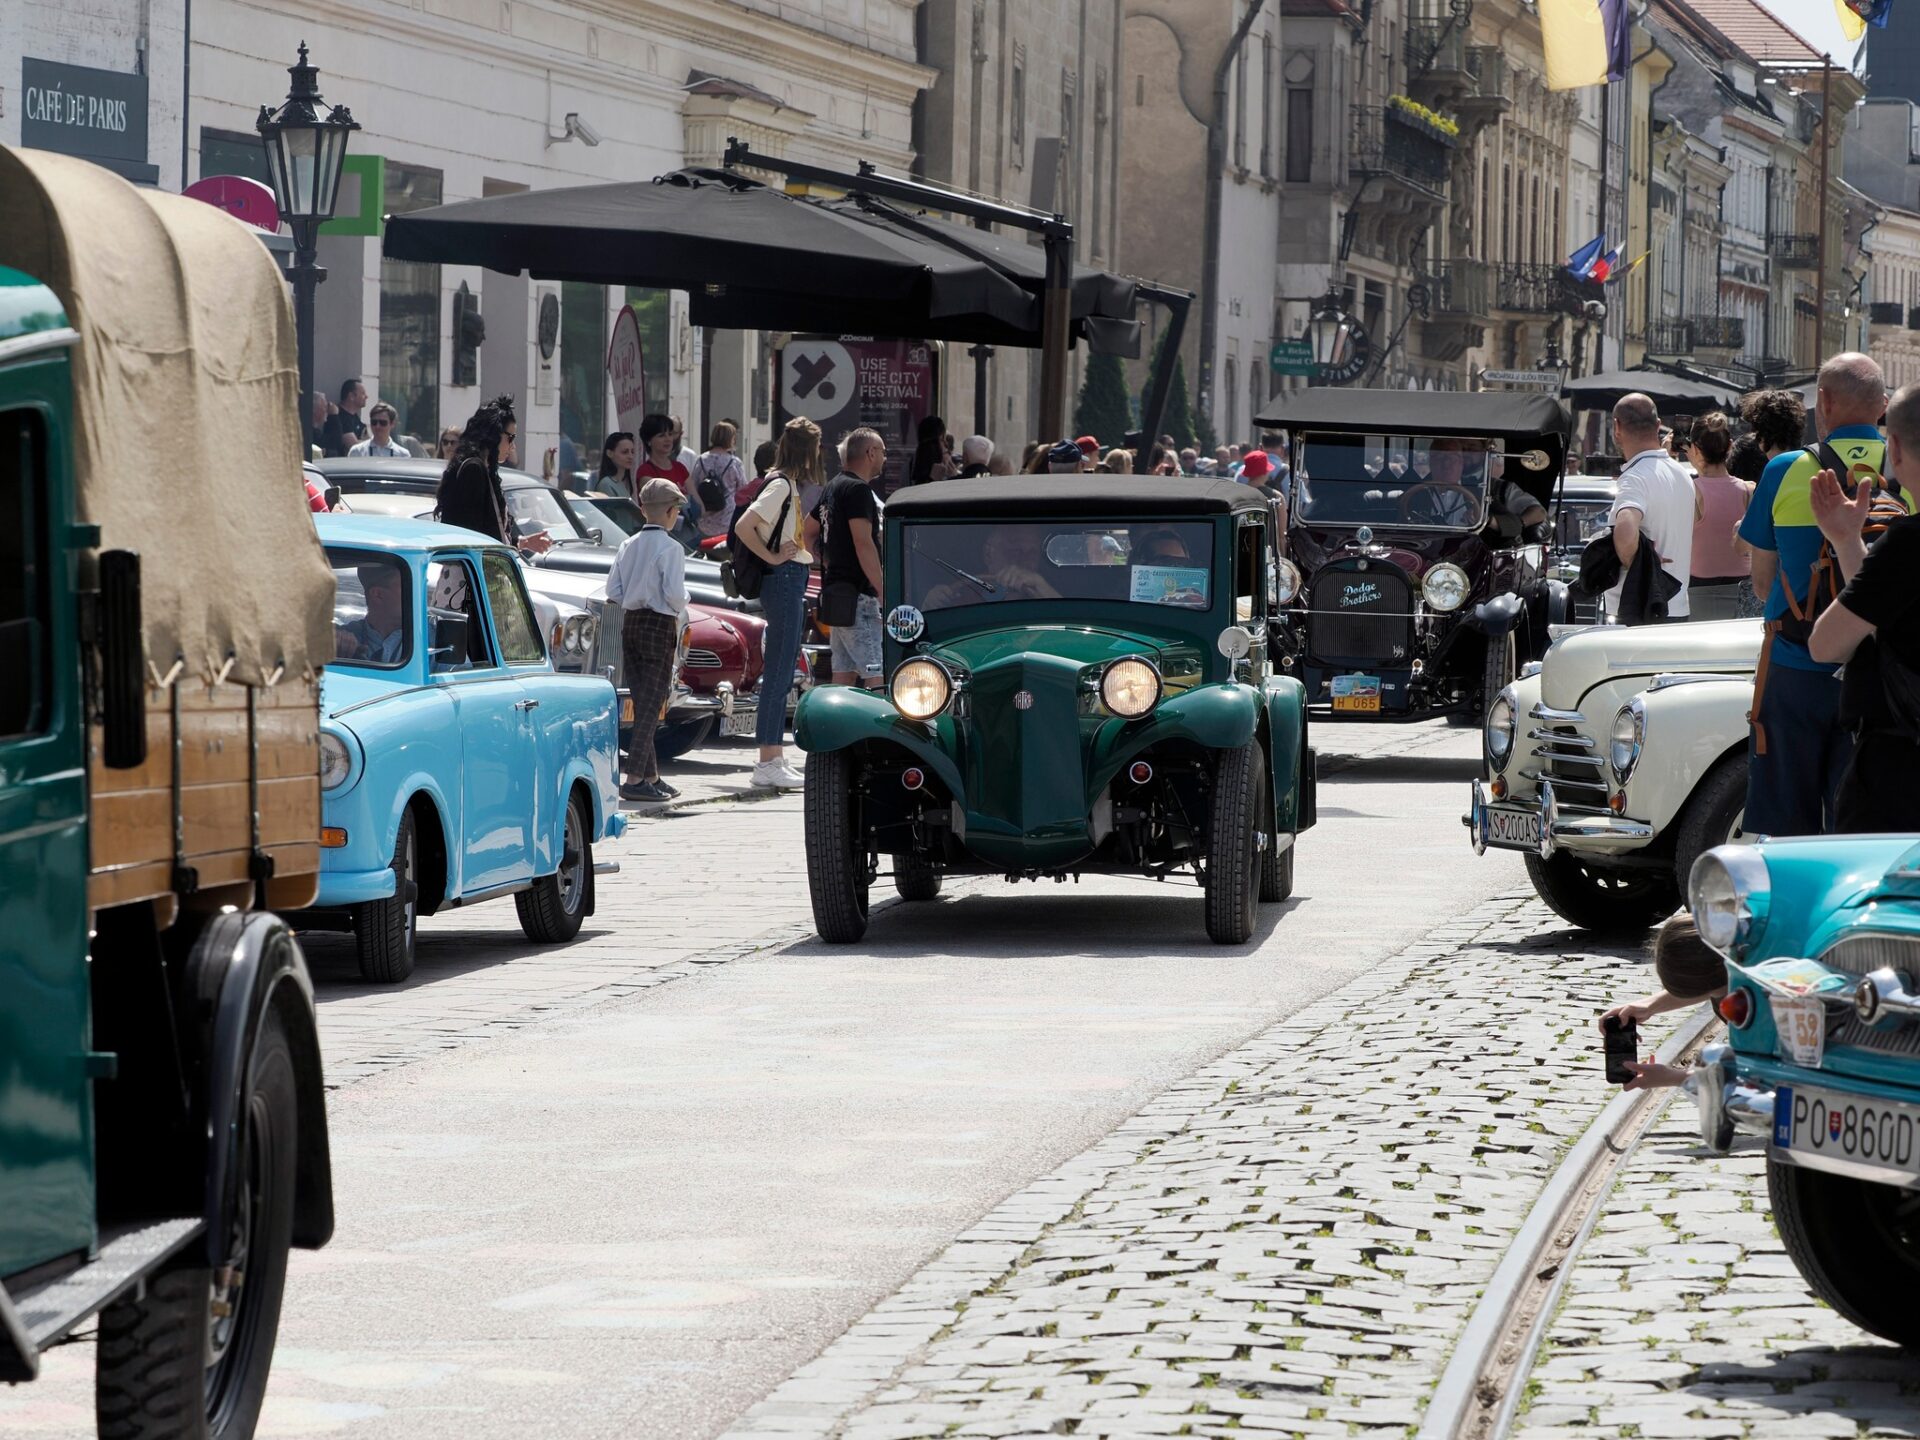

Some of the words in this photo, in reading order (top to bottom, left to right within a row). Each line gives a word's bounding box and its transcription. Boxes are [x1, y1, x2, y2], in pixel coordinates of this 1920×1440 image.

[26, 81, 62, 123] CAFÉ
[66, 93, 84, 126] DE
[88, 96, 126, 132] PARIS
[839, 334, 874, 342] JCDecaux
[860, 358, 887, 371] USE
[860, 371, 886, 384] THE
[860, 385, 922, 398] FESTIVAL
[1343, 582, 1376, 596] Dodge
[1340, 592, 1382, 608] Brothers
[1353, 698, 1376, 709] 065
[1843, 1105, 1920, 1166] 860D
